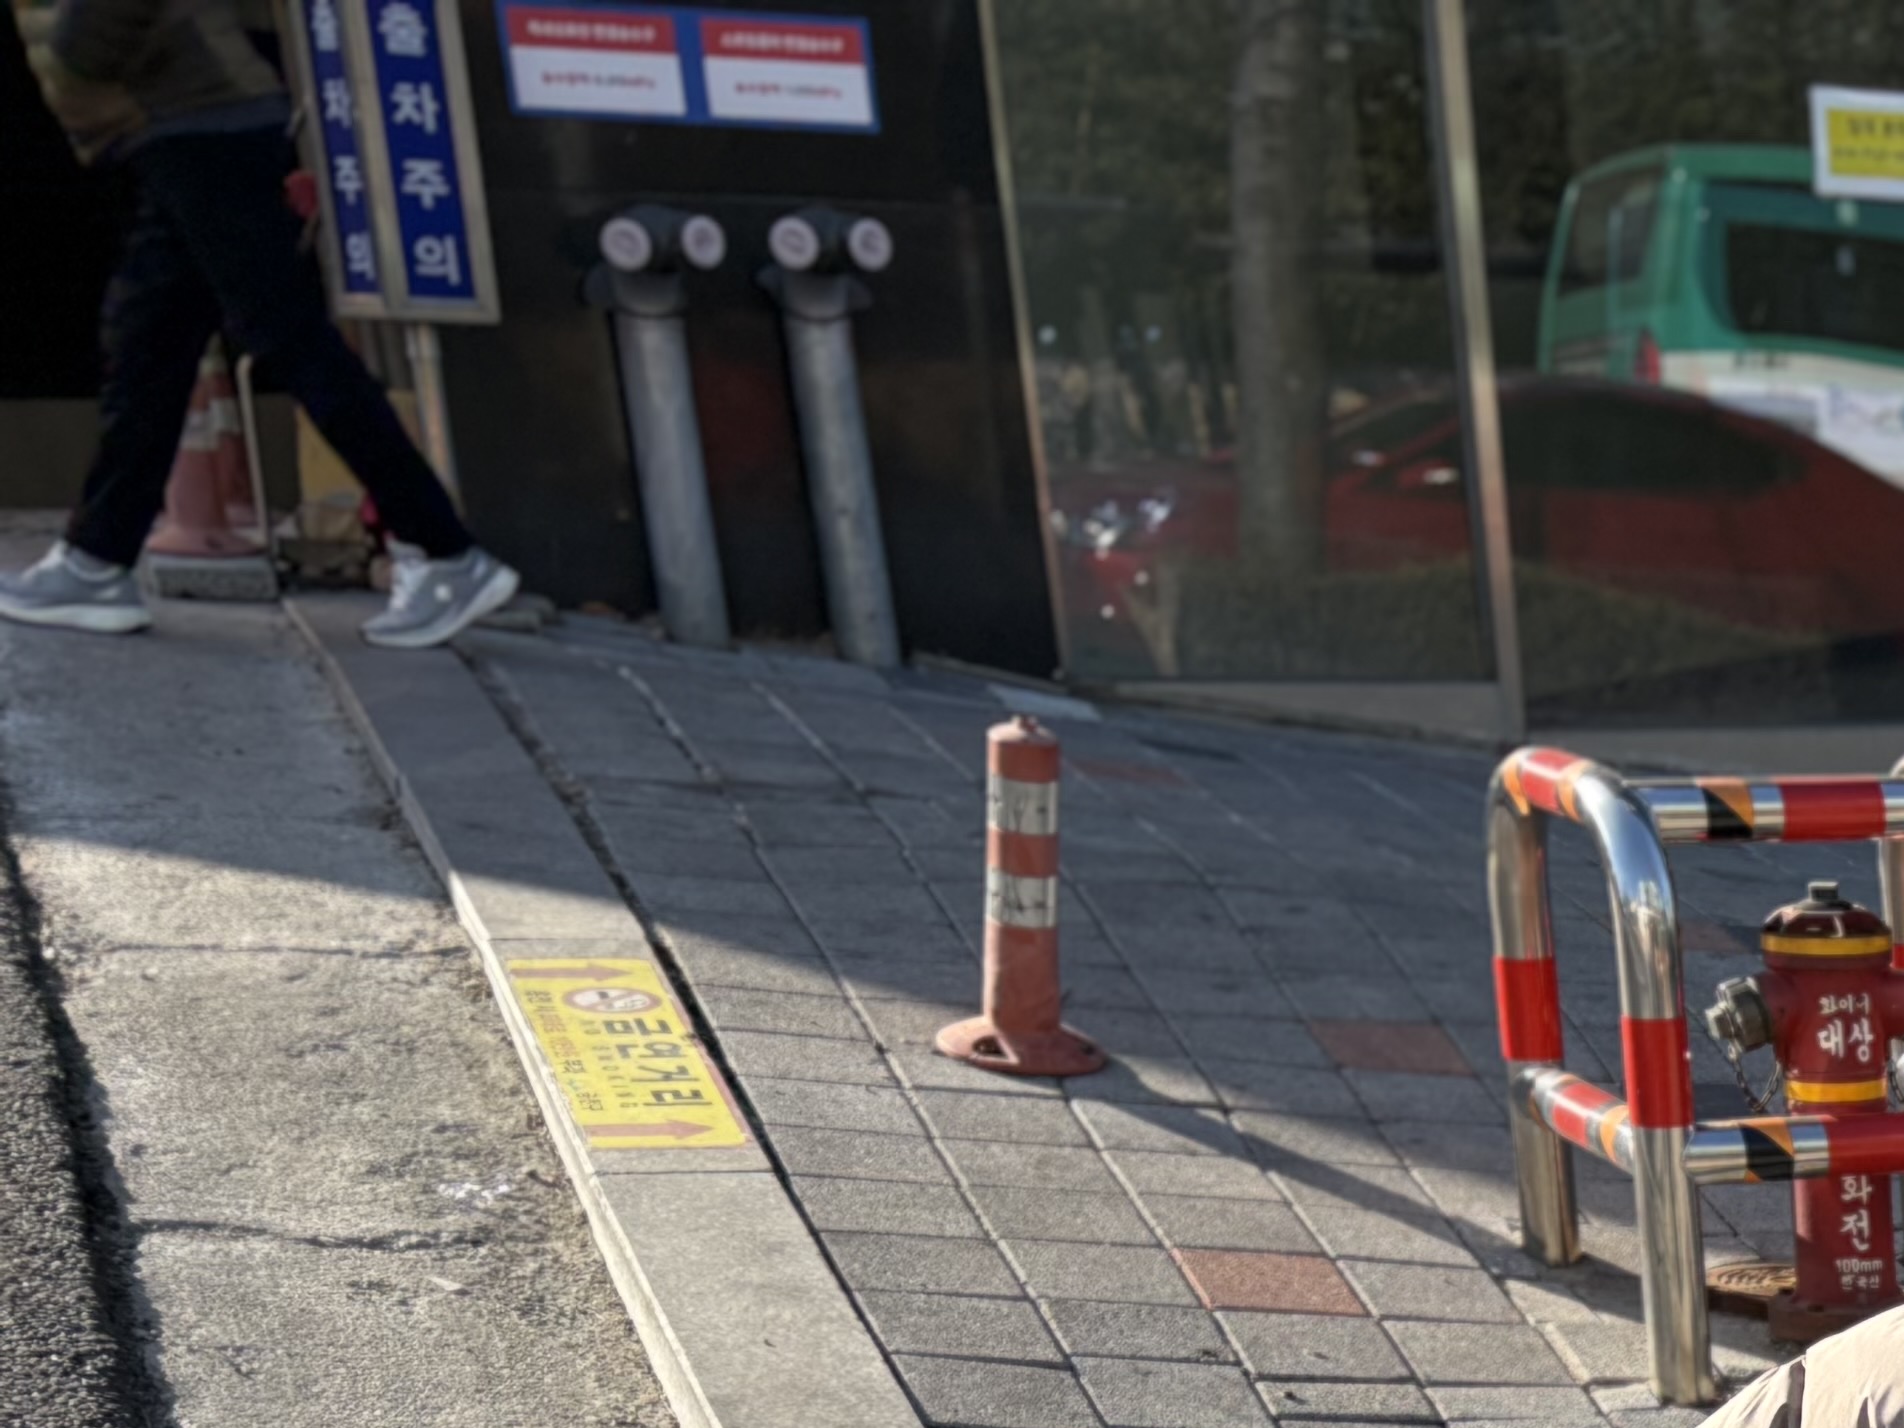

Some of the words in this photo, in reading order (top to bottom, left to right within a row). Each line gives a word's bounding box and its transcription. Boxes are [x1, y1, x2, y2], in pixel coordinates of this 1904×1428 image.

[377, 2, 462, 286] 출차주의
[600, 1017, 713, 1107] 금연거리
[1817, 1017, 1874, 1063] 대상
[1836, 1259, 1883, 1274] 100mm
